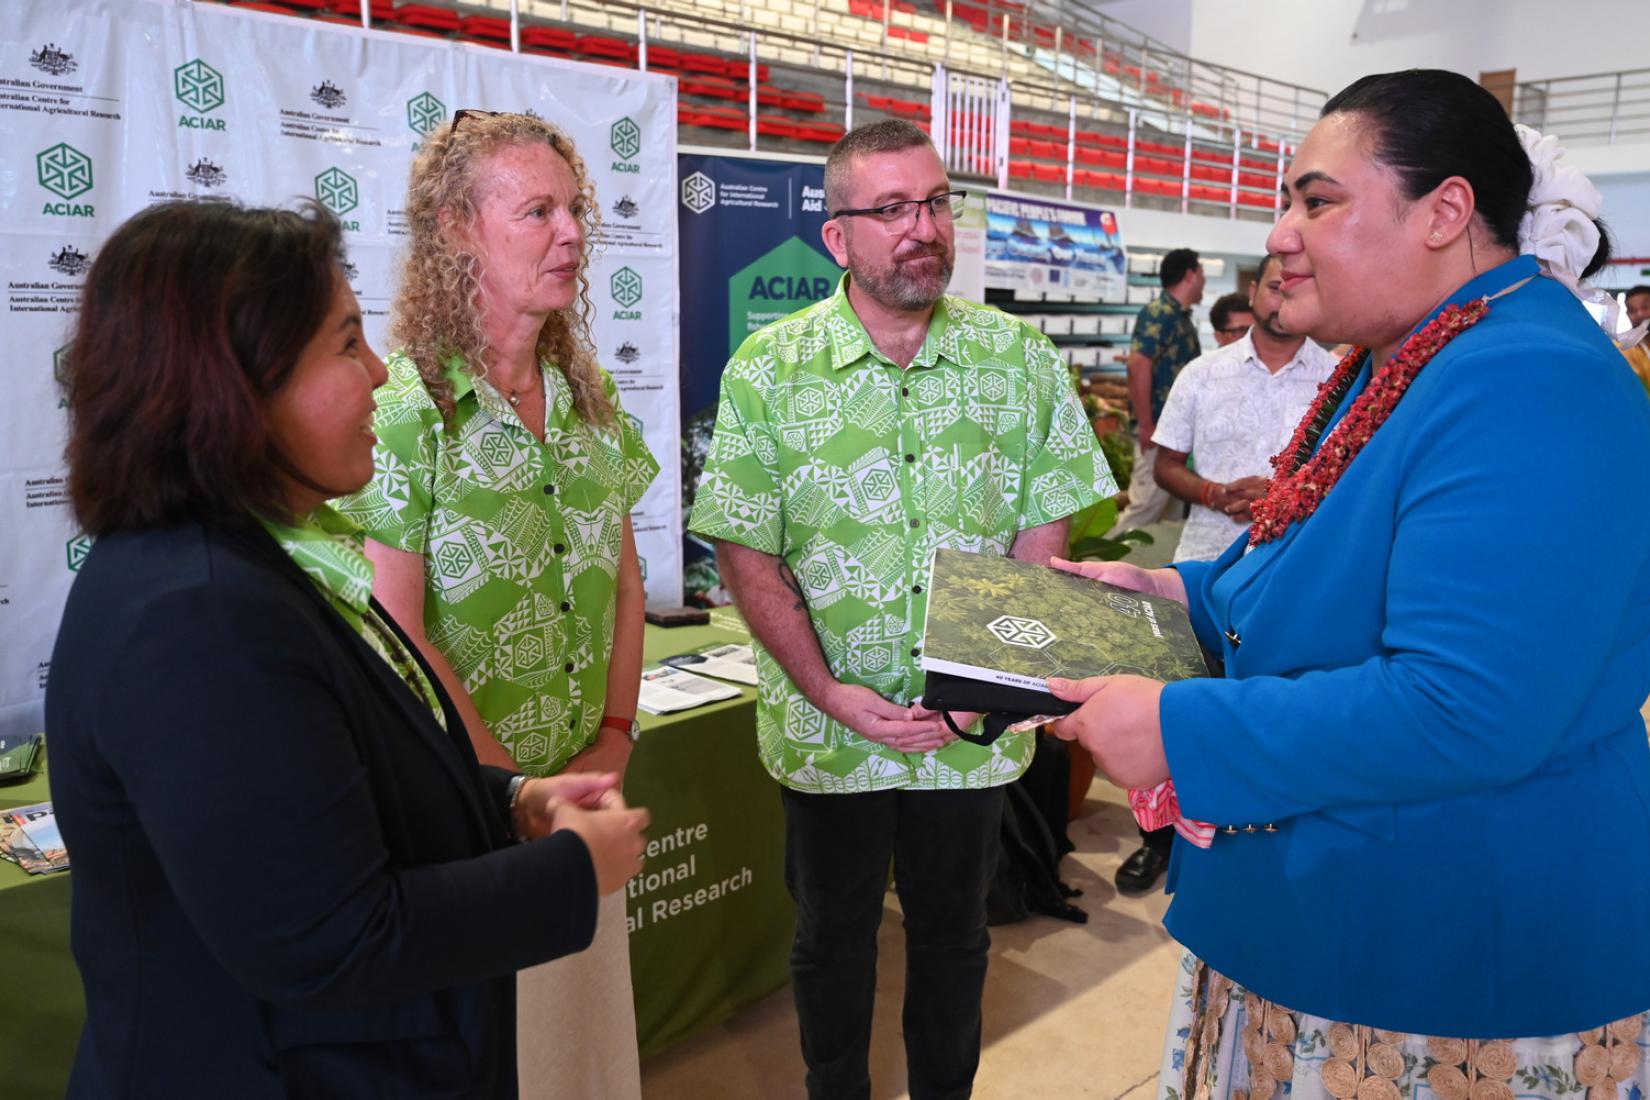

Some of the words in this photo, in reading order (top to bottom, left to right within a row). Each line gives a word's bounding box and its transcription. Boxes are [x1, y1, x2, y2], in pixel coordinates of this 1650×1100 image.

[32, 80, 83, 92] Government
[32, 95, 57, 104] Centre
[59, 97, 70, 105] for
[42, 105, 88, 116] Agricultural
[90, 110, 121, 120] Research
[280, 108, 311, 118] Australian
[311, 113, 350, 123] Government
[178, 114, 226, 131] ACIAR
[281, 122, 310, 131] Australian
[612, 162, 640, 173] ACIAR
[720, 183, 748, 191] Australian
[149, 190, 186, 199] Australian
[729, 191, 765, 200] International
[720, 198, 752, 206] Agricultural
[753, 200, 779, 208] Research
[801, 199, 822, 212] Aid
[42, 202, 95, 217] ACIAR
[8, 281, 49, 290] Australian
[750, 275, 831, 300] ACIAR
[9, 296, 48, 304] Australian
[9, 305, 57, 313] International
[613, 311, 642, 321] ACIAR
[25, 477, 63, 487] Australian
[1004, 676, 1022, 684] YEARS
[639, 822, 708, 861] entre
[652, 866, 753, 923] Research
